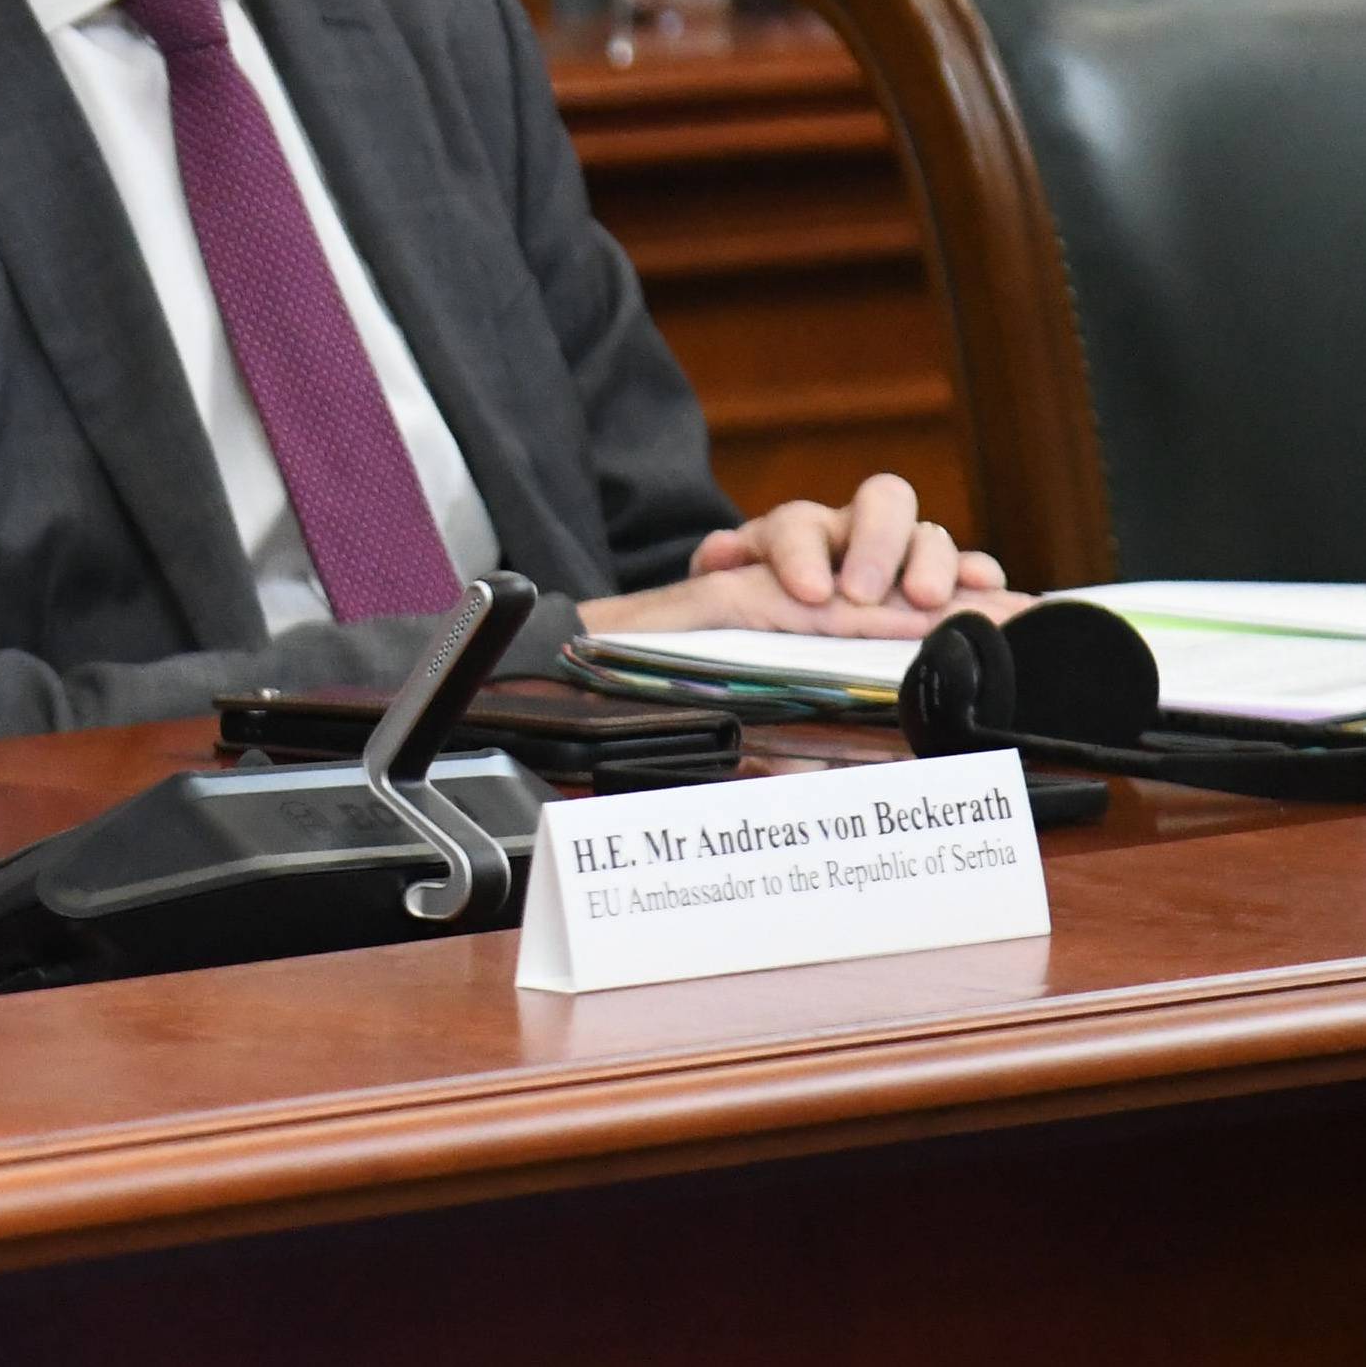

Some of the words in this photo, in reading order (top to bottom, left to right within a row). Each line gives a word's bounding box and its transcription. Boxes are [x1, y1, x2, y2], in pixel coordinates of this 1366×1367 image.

[572, 834, 637, 874] H.E.
[643, 828, 687, 865] Mr
[696, 818, 810, 858] Andreas
[817, 813, 868, 841] von
[872, 787, 1013, 836] Beckerath
[587, 888, 620, 919] EU
[629, 873, 756, 914] Ambassador
[761, 874, 783, 896] to
[788, 863, 820, 893] the
[825, 851, 918, 892] Republic
[925, 845, 947, 875] of
[951, 837, 1018, 872] Serbia
